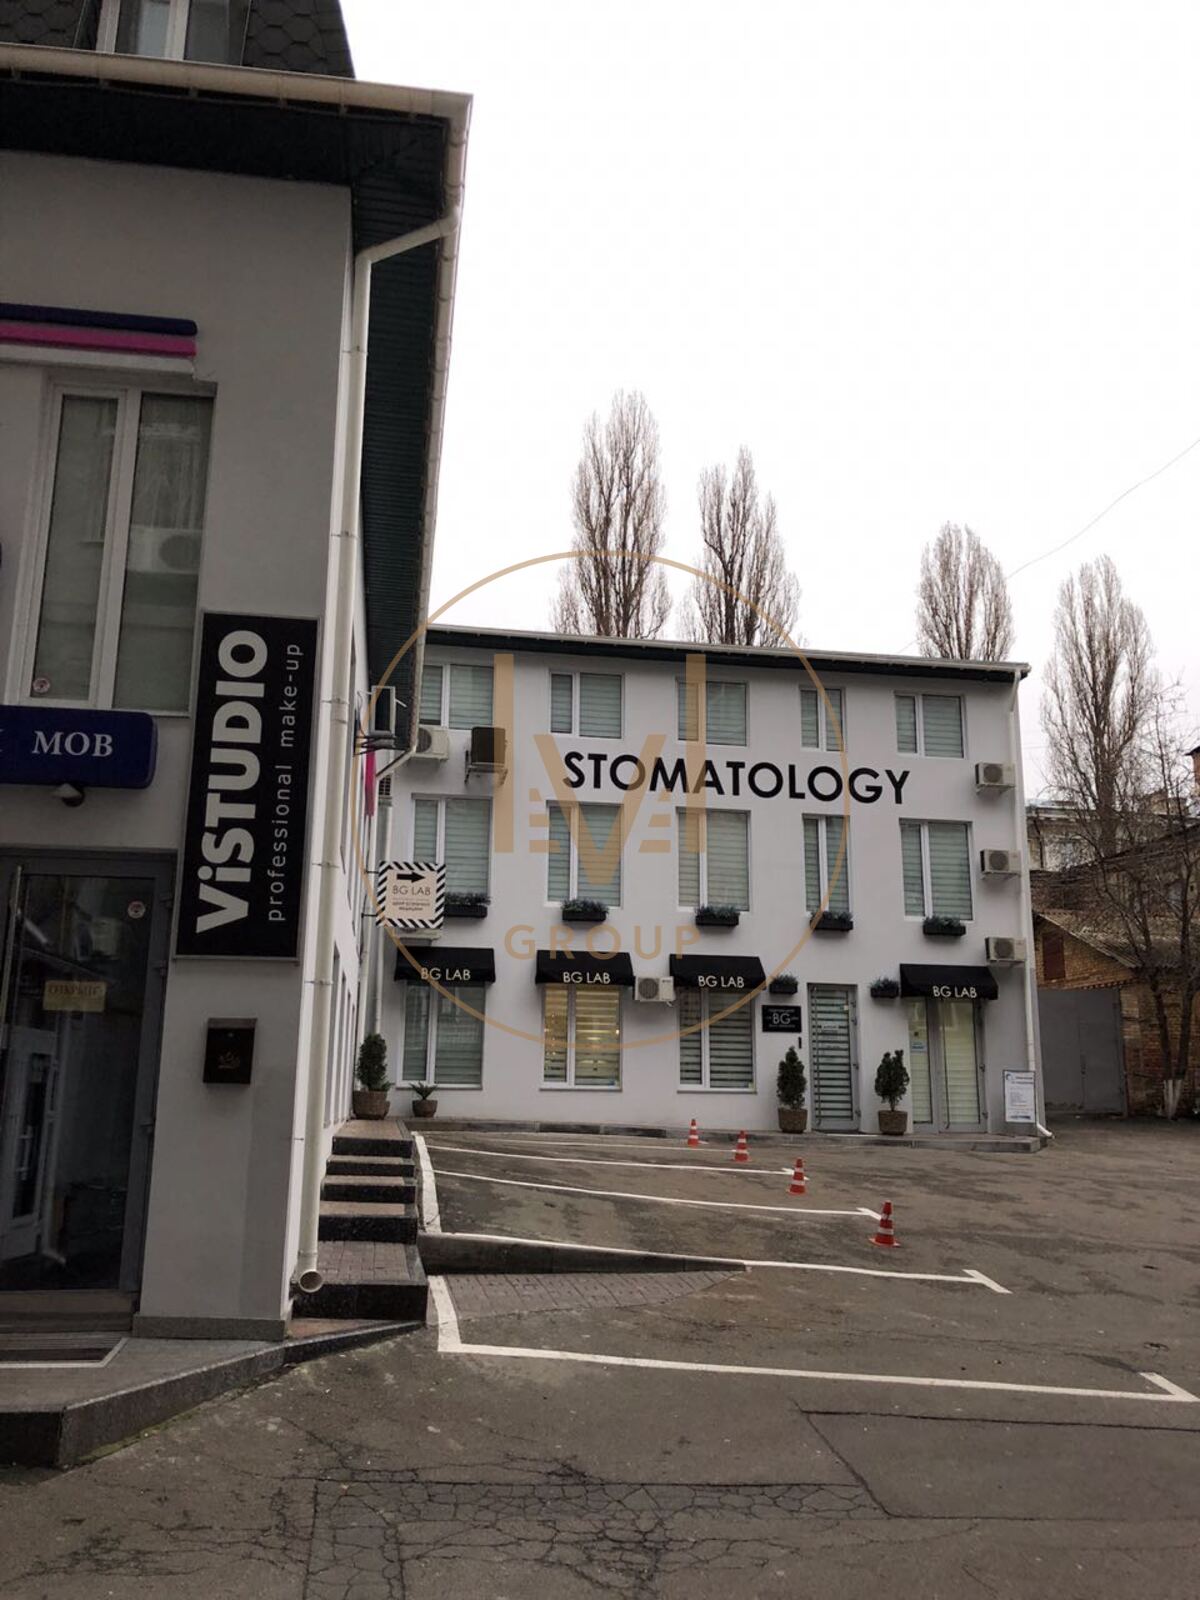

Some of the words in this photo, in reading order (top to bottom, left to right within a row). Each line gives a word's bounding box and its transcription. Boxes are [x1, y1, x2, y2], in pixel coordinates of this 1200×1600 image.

[279, 643, 304, 747] make-up
[563, 751, 910, 804] STOMATOLOGY
[268, 764, 293, 922] professional
[392, 885, 408, 895] BG
[411, 886, 431, 896] LAB
[420, 968, 442, 980] BG
[446, 969, 471, 981] LAB
[563, 971, 583, 983] BG
[586, 972, 611, 984] LAB
[698, 975, 718, 987] BG
[721, 976, 745, 988] LAB
[932, 985, 951, 997] BG
[954, 986, 977, 999] LAB
[773, 1012, 791, 1025] BG
